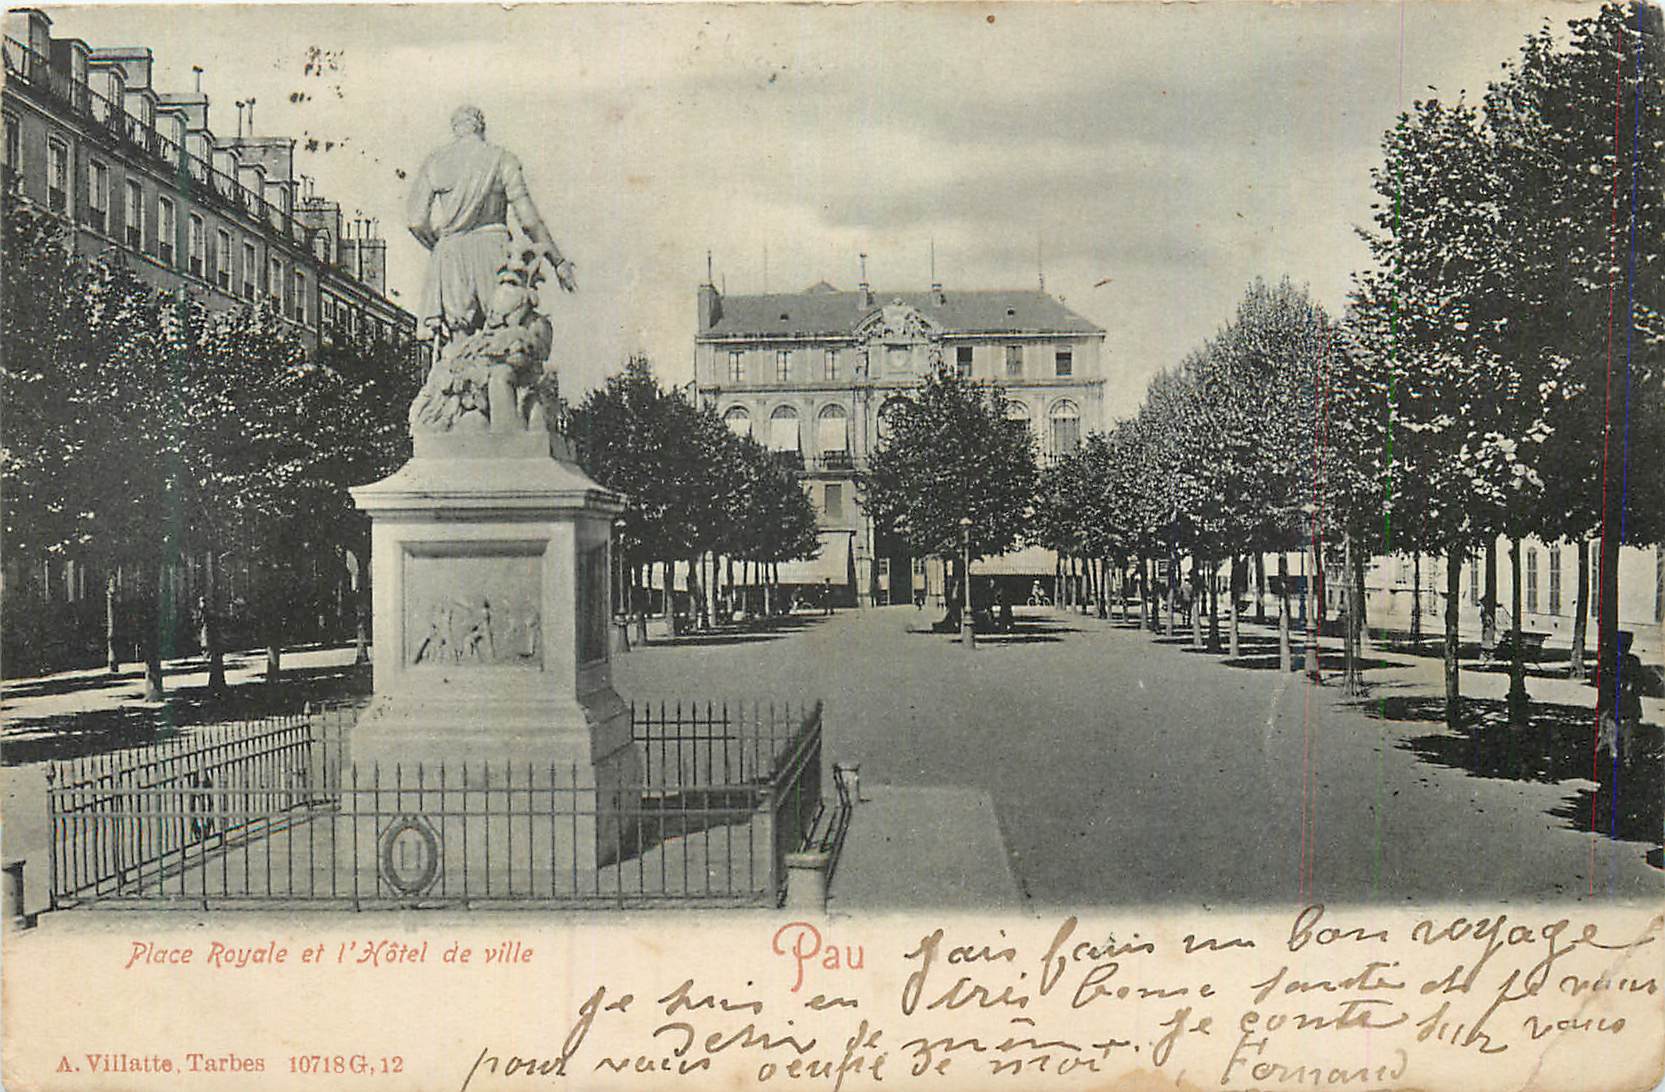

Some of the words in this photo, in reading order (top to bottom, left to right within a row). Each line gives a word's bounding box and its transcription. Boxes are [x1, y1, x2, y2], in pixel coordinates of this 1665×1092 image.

[1287, 903, 1389, 952] bon
[1412, 914, 1656, 992] voyage
[805, 994, 858, 1011] en
